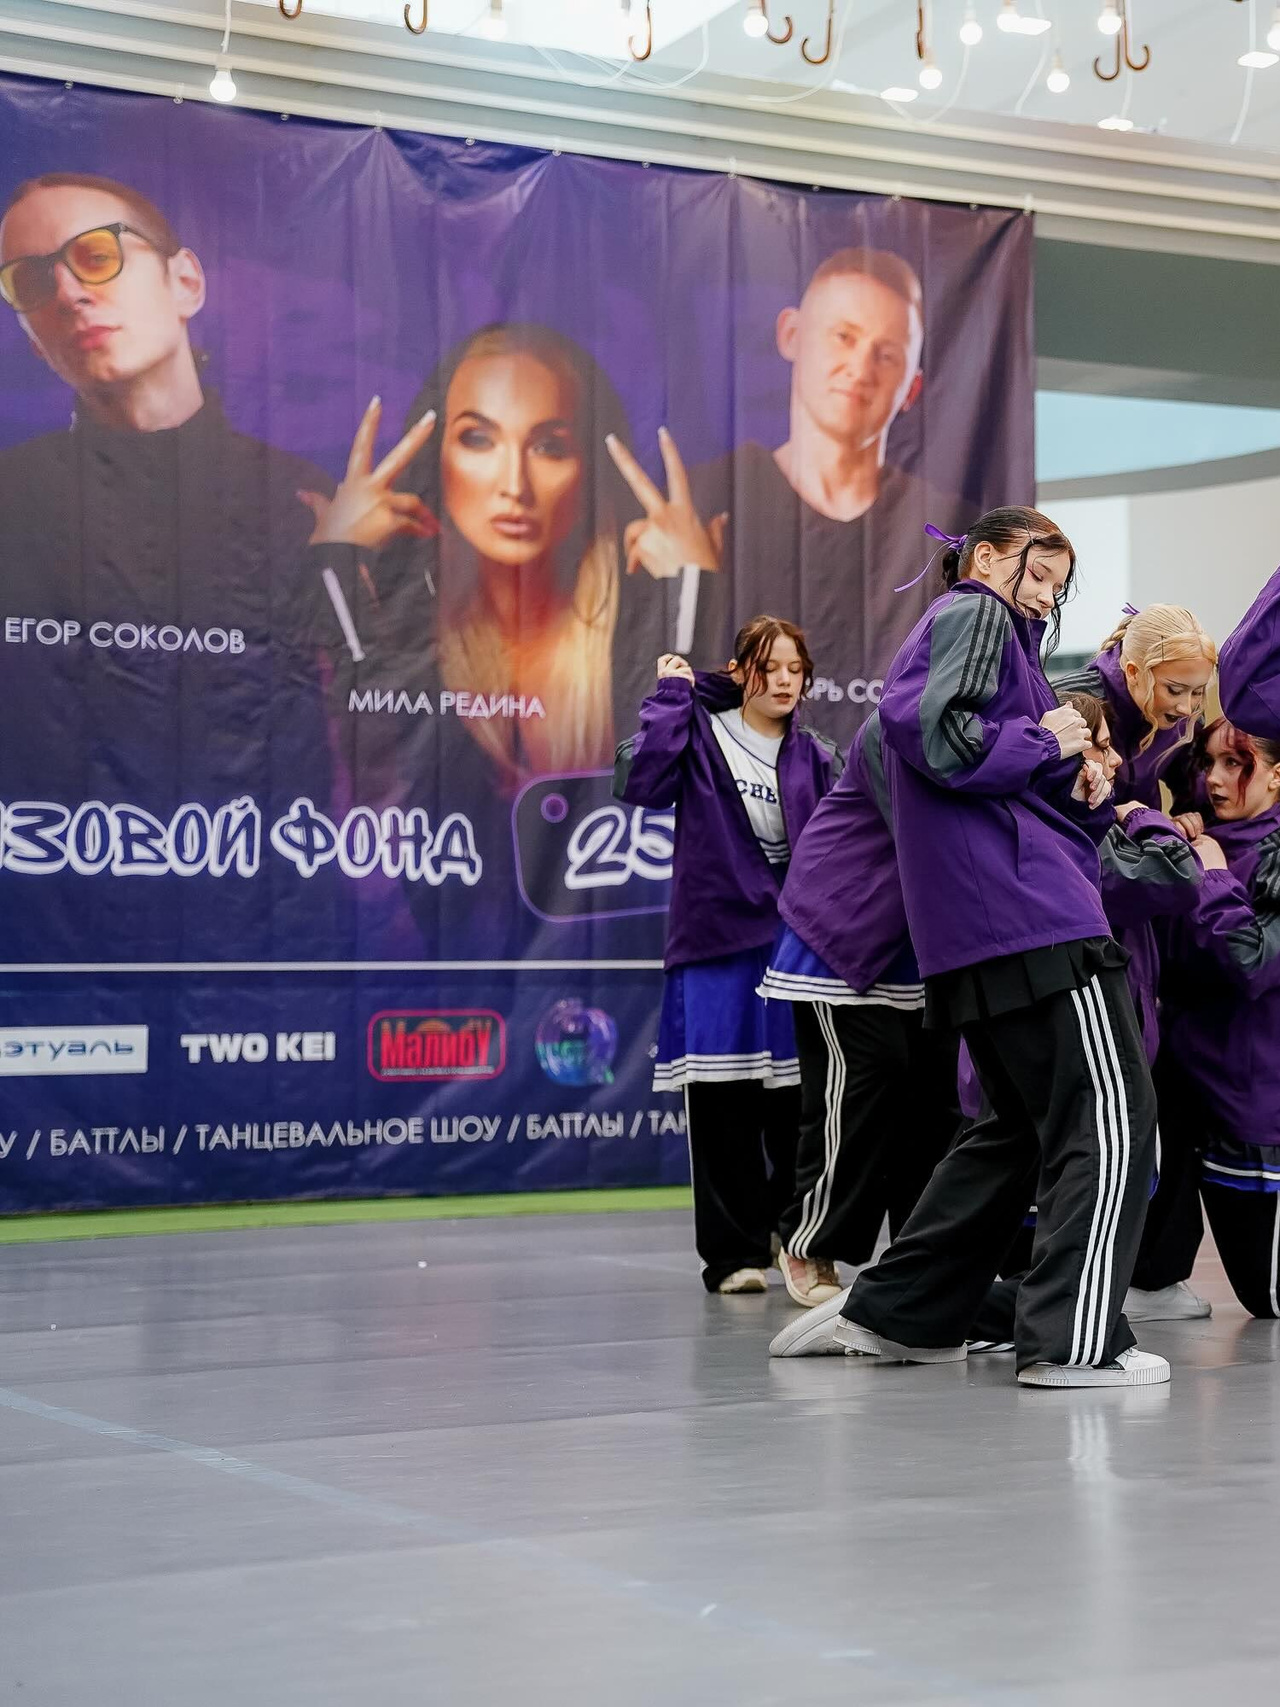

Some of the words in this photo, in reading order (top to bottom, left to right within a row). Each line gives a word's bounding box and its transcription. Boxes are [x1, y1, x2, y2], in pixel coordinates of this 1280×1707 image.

[5, 617, 81, 645] ЕГОР
[89, 621, 246, 654] СОКОЛОВ
[349, 689, 434, 716] МИЛА
[440, 691, 546, 719] РЕДИНА
[0, 795, 261, 878] ЗОВОЙ
[270, 797, 482, 886] ФОНД
[0, 1040, 133, 1062] этуаль
[180, 1033, 269, 1064] TWO
[276, 1031, 336, 1062] KEI
[50, 1126, 165, 1157] БАТТЛЫ
[195, 1117, 424, 1152] ТАНЦЕВАЛЬНОЕ
[431, 1114, 502, 1143] ШОУ
[526, 1111, 624, 1140] БАТТЛЫ
